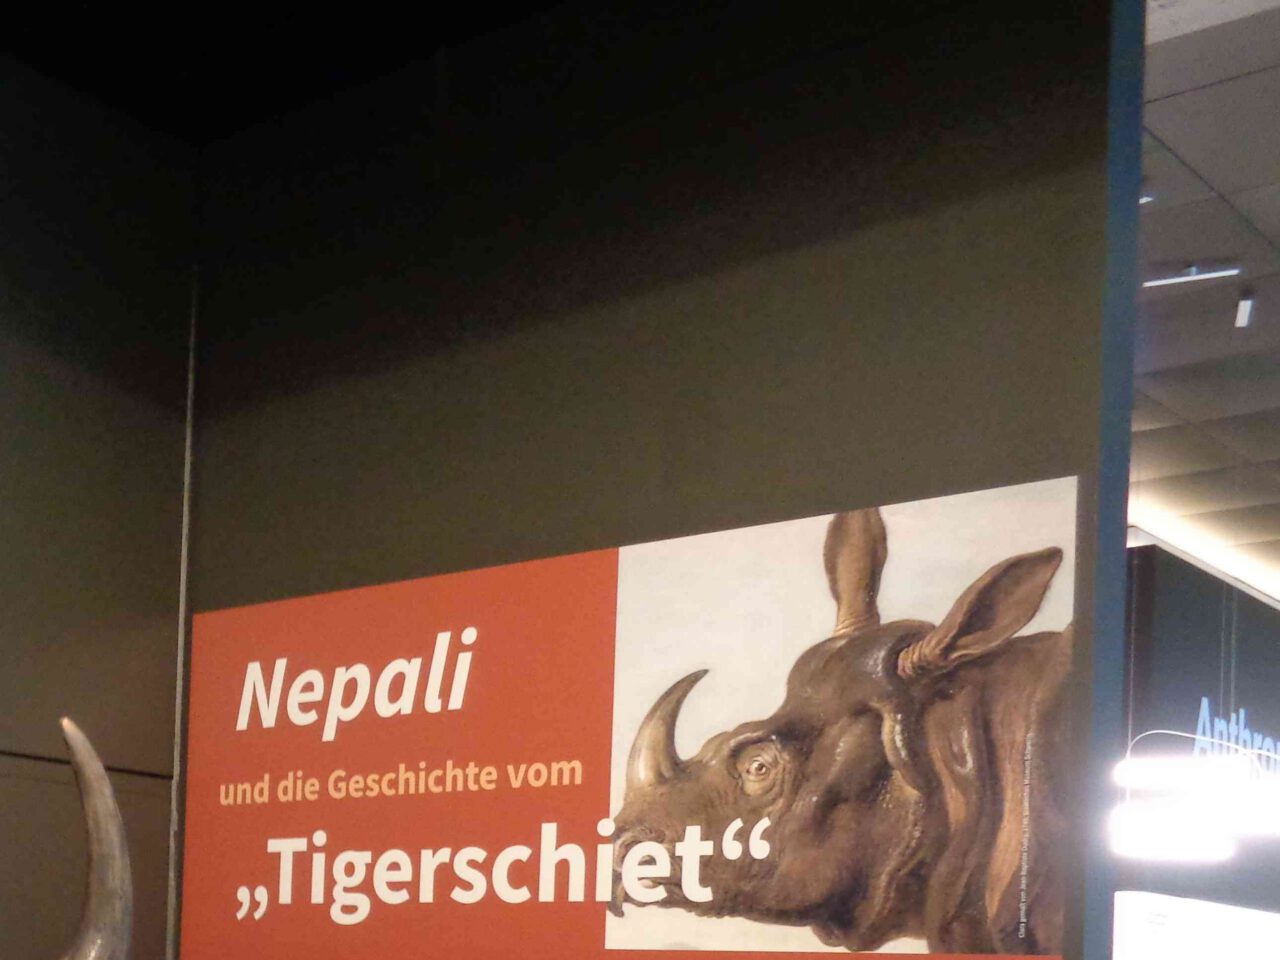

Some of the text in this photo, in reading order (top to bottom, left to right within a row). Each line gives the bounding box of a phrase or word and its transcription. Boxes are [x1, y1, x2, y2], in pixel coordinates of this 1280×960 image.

[236, 627, 478, 742] Nepali
[1192, 696, 1280, 774] Anthro
[220, 759, 583, 806] und die Geschichte vom
